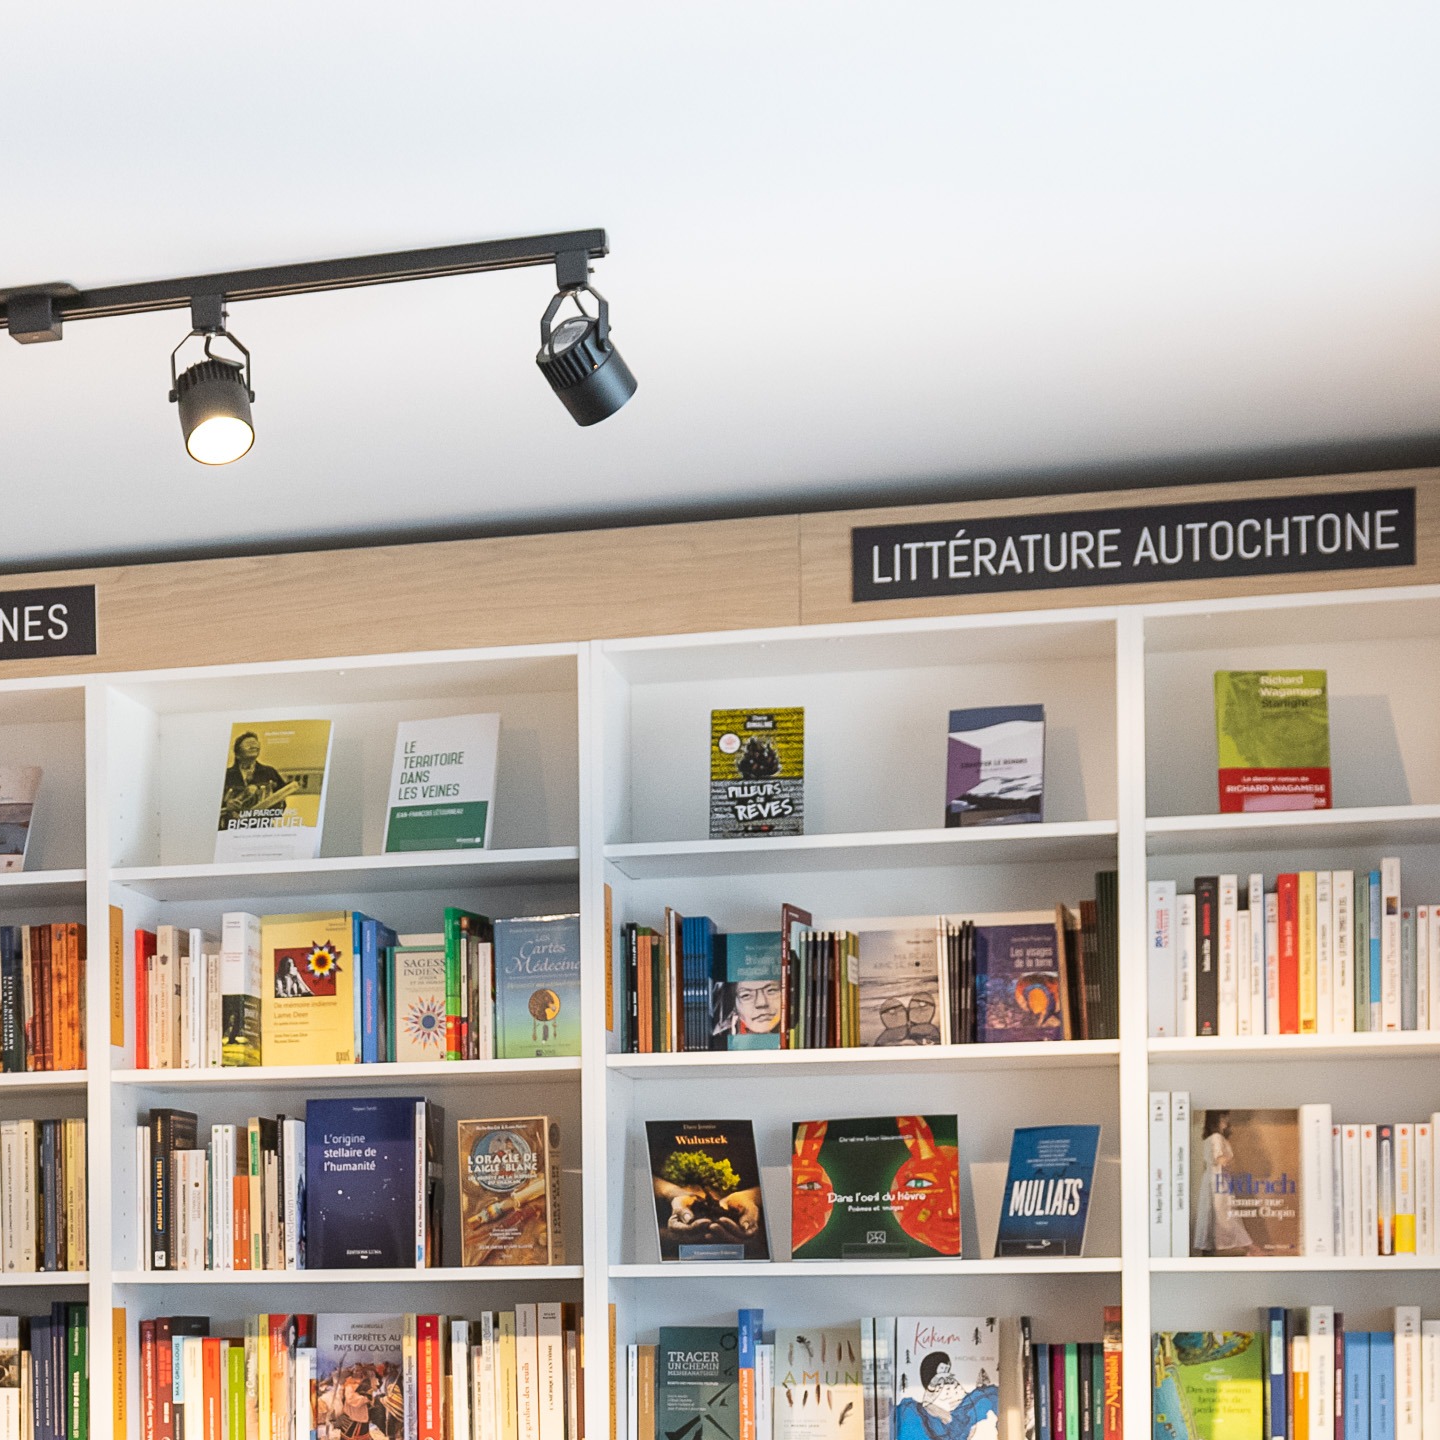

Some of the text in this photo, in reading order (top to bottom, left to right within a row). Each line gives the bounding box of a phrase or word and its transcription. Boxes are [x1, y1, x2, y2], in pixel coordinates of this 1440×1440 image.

[871, 509, 1400, 585] LITTÉRATURE AUTOCHTONE
[1261, 675, 1304, 686] Richard
[1261, 686, 1323, 698] Wagamese
[405, 741, 416, 754] LE
[404, 752, 464, 768] TERRITOIRE
[401, 771, 429, 785] DANS
[398, 784, 460, 800] LES VEINES
[727, 782, 782, 798] PILLEURS
[736, 799, 793, 822] RÊVES
[518, 941, 566, 962] Cartes
[505, 957, 580, 975] Médecine
[324, 1133, 365, 1146] L'origine
[675, 1135, 727, 1145] Wulustek
[324, 1147, 376, 1158] stellaire de
[324, 1160, 376, 1172] l'humanité
[827, 1192, 853, 1203] Dans
[882, 1192, 895, 1202] du
[1009, 1179, 1084, 1216] MULIATS
[334, 1331, 401, 1342] INTERPRÈTES AU
[914, 1322, 960, 1353] Kukum
[334, 1344, 401, 1352] PAYS DU CASTOR
[668, 1352, 719, 1363] TRACER
[682, 1363, 719, 1371] CHEMIN
[783, 1370, 860, 1387] AMUN
